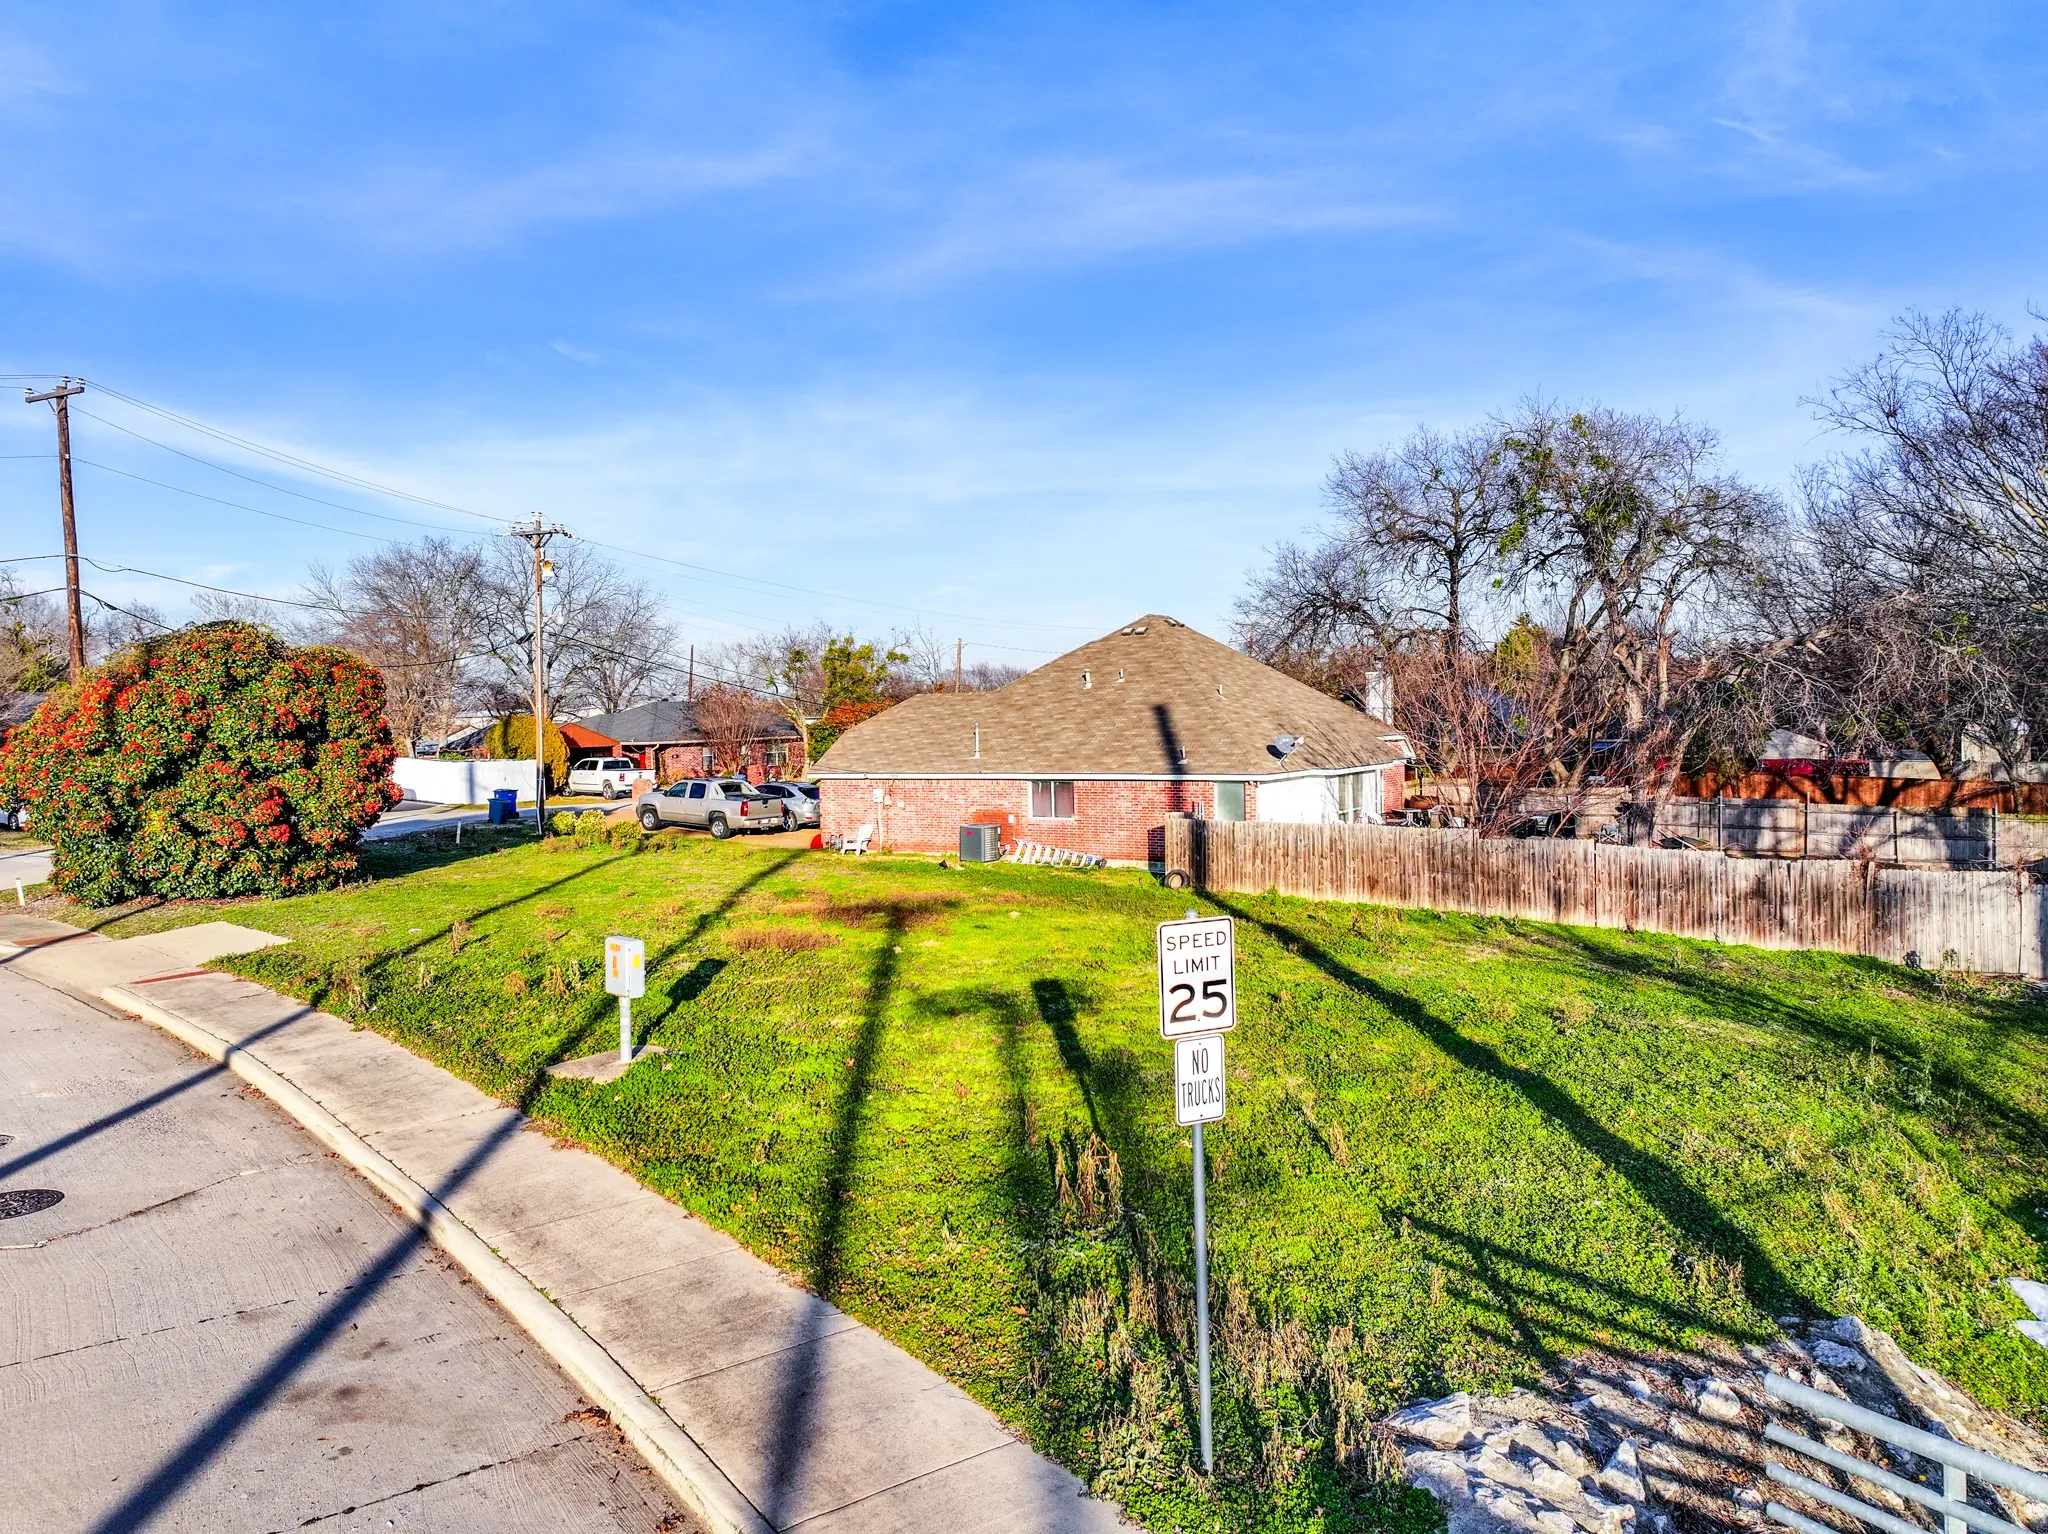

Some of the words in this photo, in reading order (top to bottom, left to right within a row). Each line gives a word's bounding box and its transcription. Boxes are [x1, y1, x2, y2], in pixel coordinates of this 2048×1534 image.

[1166, 931, 1227, 951] SPEED
[1174, 956, 1220, 975] LIMIT
[1169, 979, 1227, 1024] 25
[1192, 1047, 1209, 1075] NO
[1181, 1076, 1221, 1109] TRUCKS
